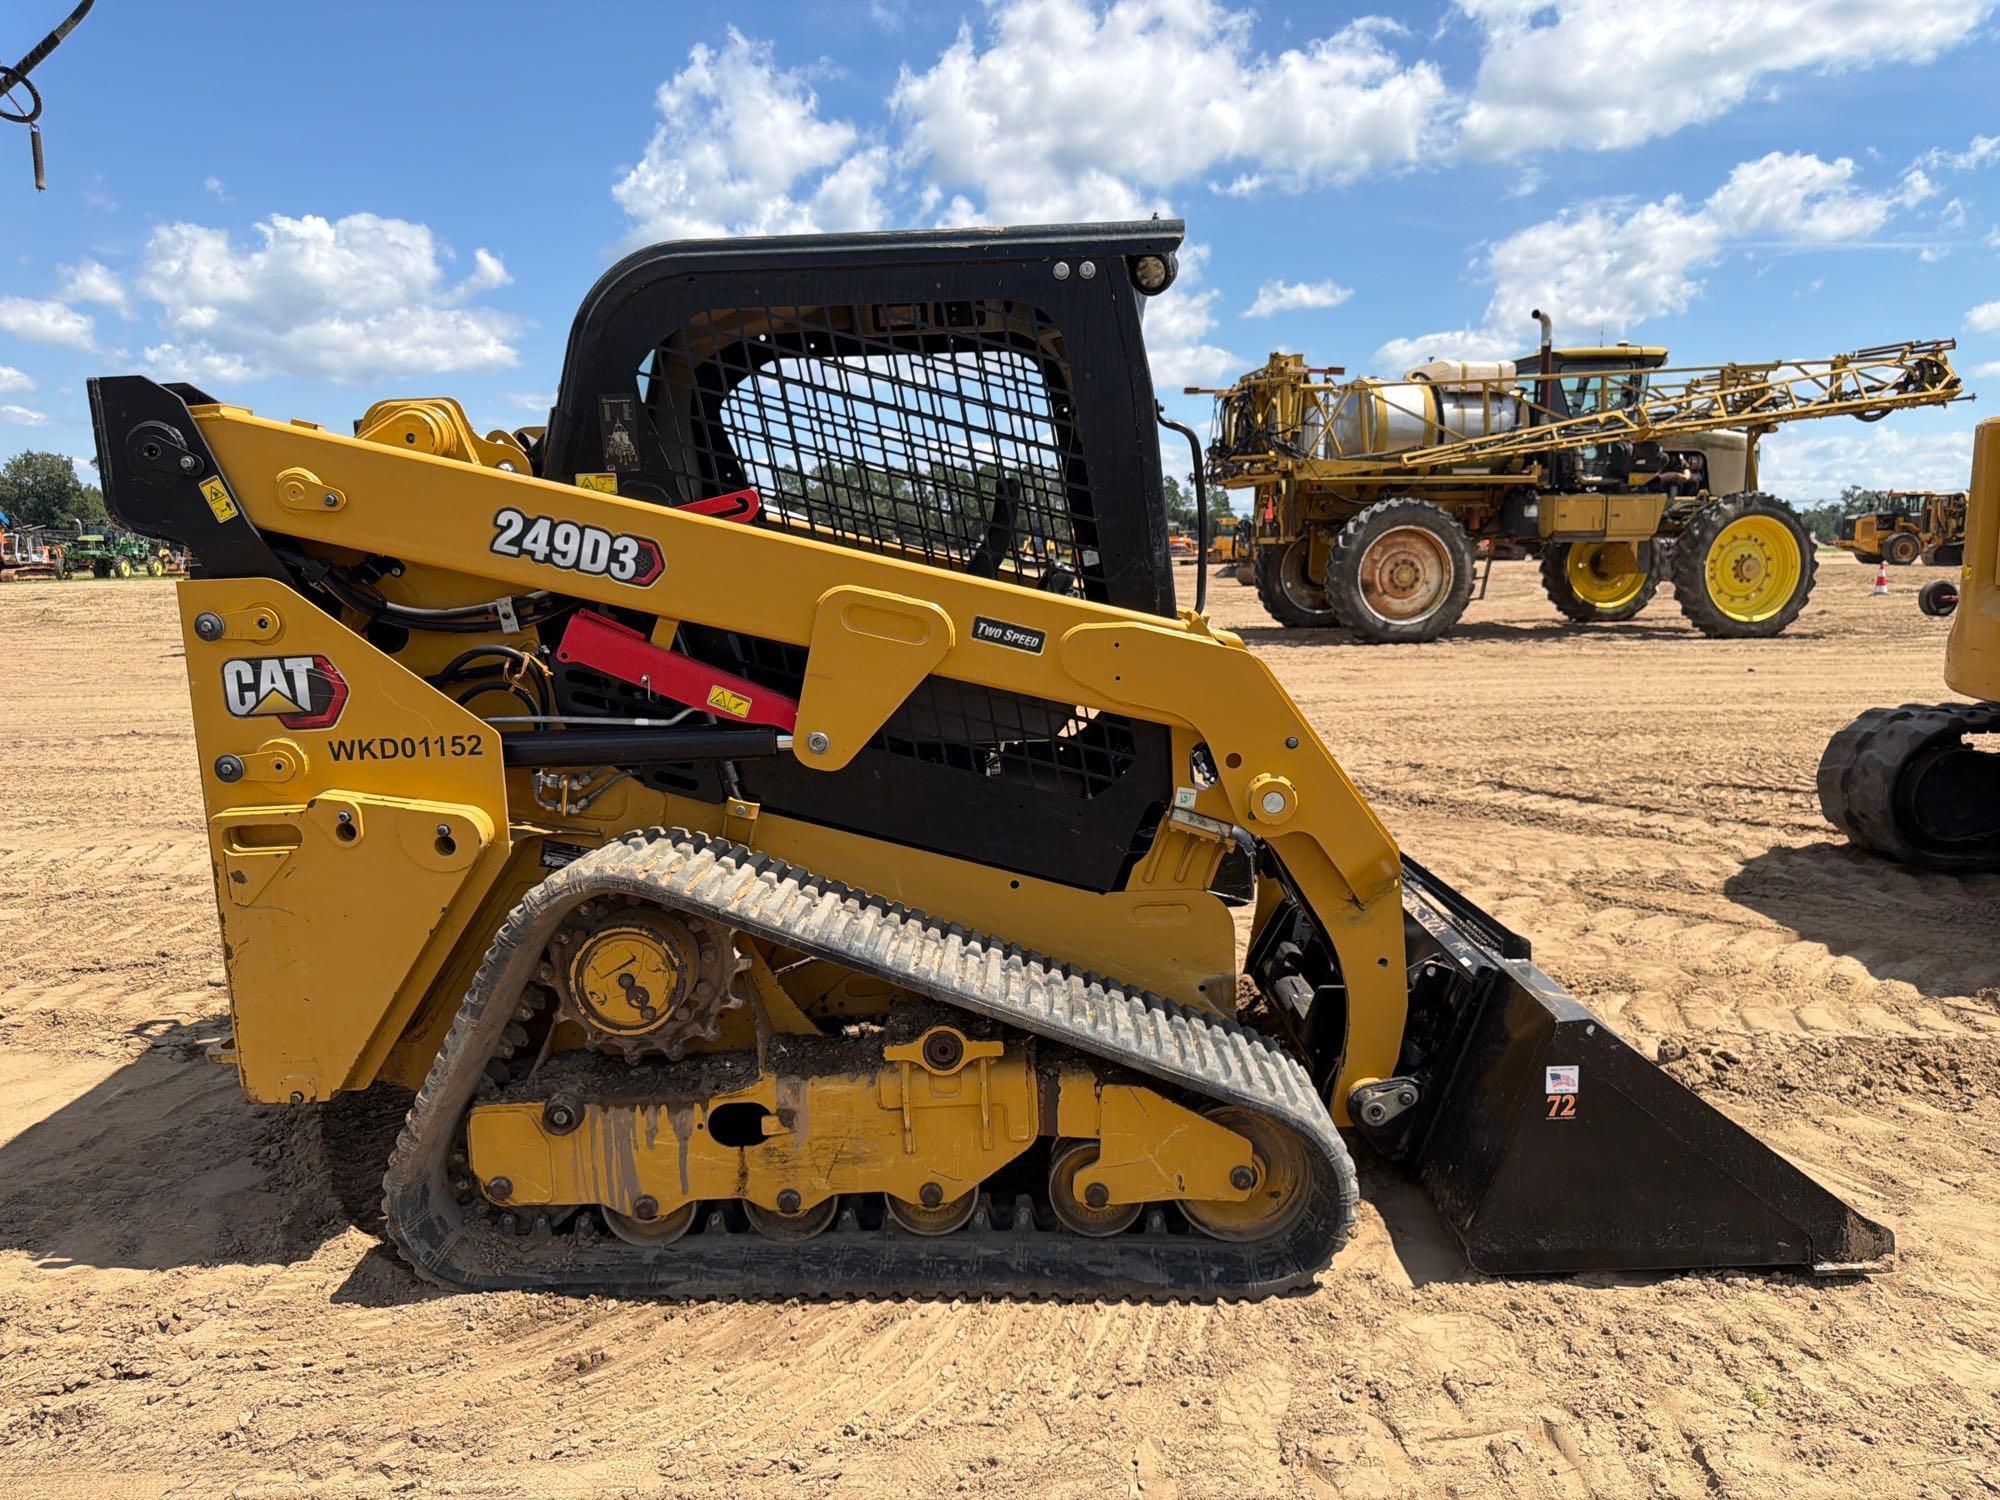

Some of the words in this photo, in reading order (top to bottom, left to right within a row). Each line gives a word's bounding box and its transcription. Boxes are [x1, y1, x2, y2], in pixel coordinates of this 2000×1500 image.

[493, 510, 639, 580] 249D3
[223, 657, 315, 715] CAT
[327, 734, 483, 762] WKD01152
[1546, 1094, 1576, 1117] 72
